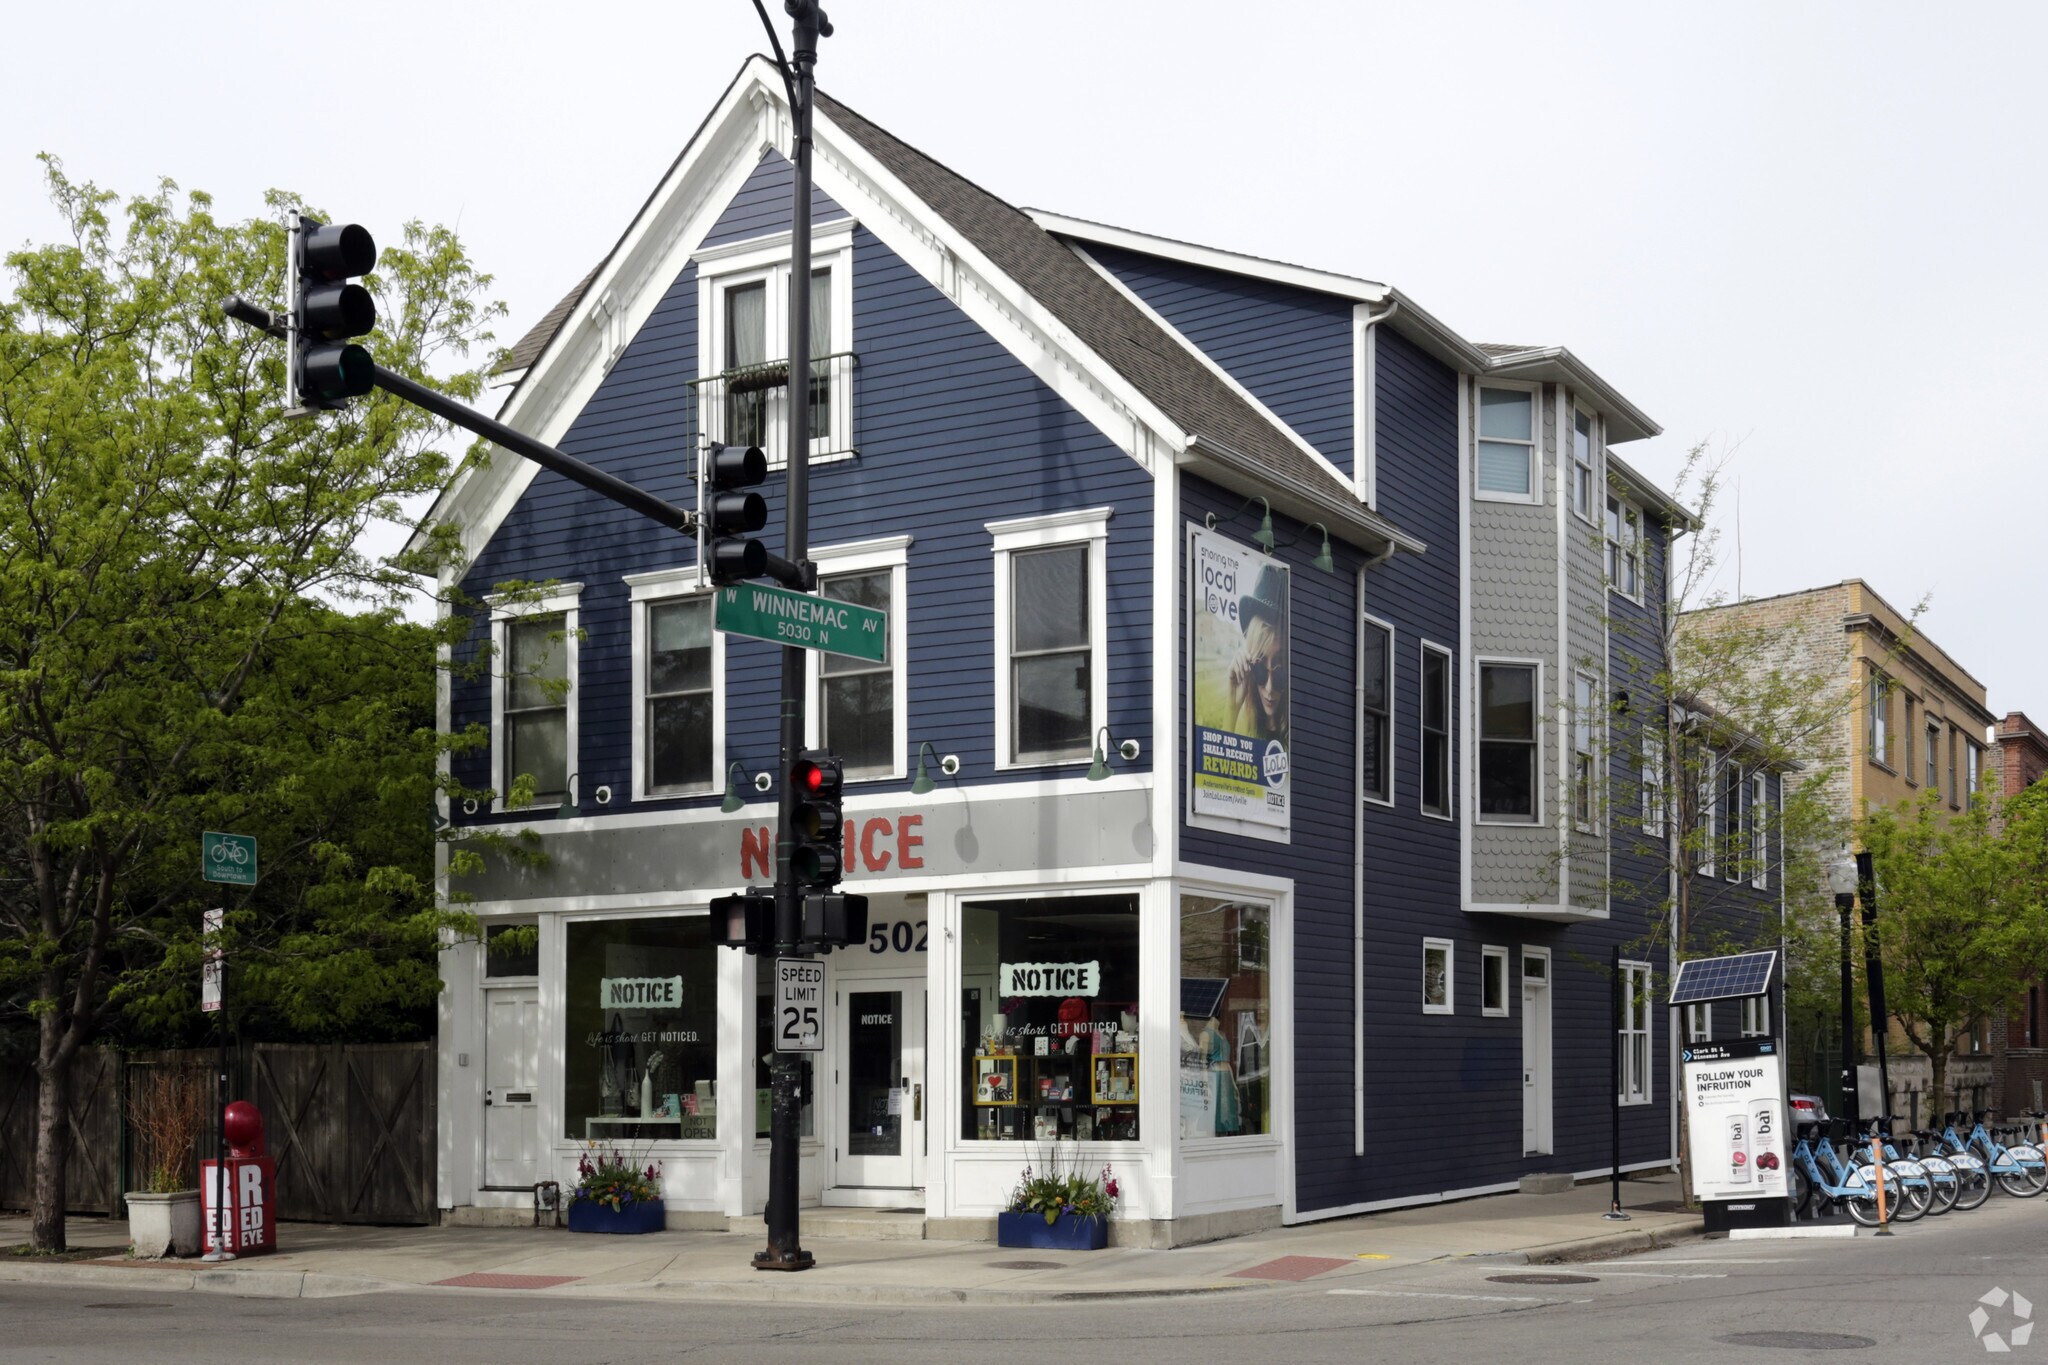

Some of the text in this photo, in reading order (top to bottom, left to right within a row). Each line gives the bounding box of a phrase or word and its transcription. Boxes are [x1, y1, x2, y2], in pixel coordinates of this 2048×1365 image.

[1201, 547, 1239, 570] sharing the
[1201, 559, 1236, 595] local
[726, 588, 878, 633] W WINNEMAC AV
[1205, 586, 1238, 621] love
[777, 621, 829, 645] 5030 N
[1202, 731, 1253, 751] SHOP AND YOU
[1202, 744, 1254, 763] SHALL RECEIVE
[1203, 755, 1258, 781] REWARDS
[740, 814, 924, 879] NICE
[212, 871, 247, 880] Downtown
[216, 864, 235, 872] South
[781, 968, 822, 983] SPEED
[1012, 968, 1088, 991] NOTICE
[610, 982, 673, 1004] NOTICE
[785, 987, 816, 1001] LIMIT
[783, 1007, 819, 1039] 25
[861, 1014, 893, 1025] NOTICE
[1006, 1026, 1016, 1036] is
[1050, 1023, 1068, 1034] GET
[585, 1031, 602, 1048] Life
[605, 1032, 613, 1044] is
[641, 1032, 657, 1042] GET
[660, 1031, 700, 1042] NOTICED.
[1696, 1068, 1764, 1083] FOLLOW YOUR
[1697, 1080, 1751, 1092] INFRUITION
[689, 1117, 707, 1126] NOT
[1754, 1110, 1771, 1135] bai
[684, 1128, 715, 1139] OPEN
[1731, 1123, 1742, 1140] bai
[239, 1164, 264, 1208] R
[240, 1206, 263, 1231] ED
[207, 1232, 232, 1248] EE
[241, 1228, 264, 1247] EYE
